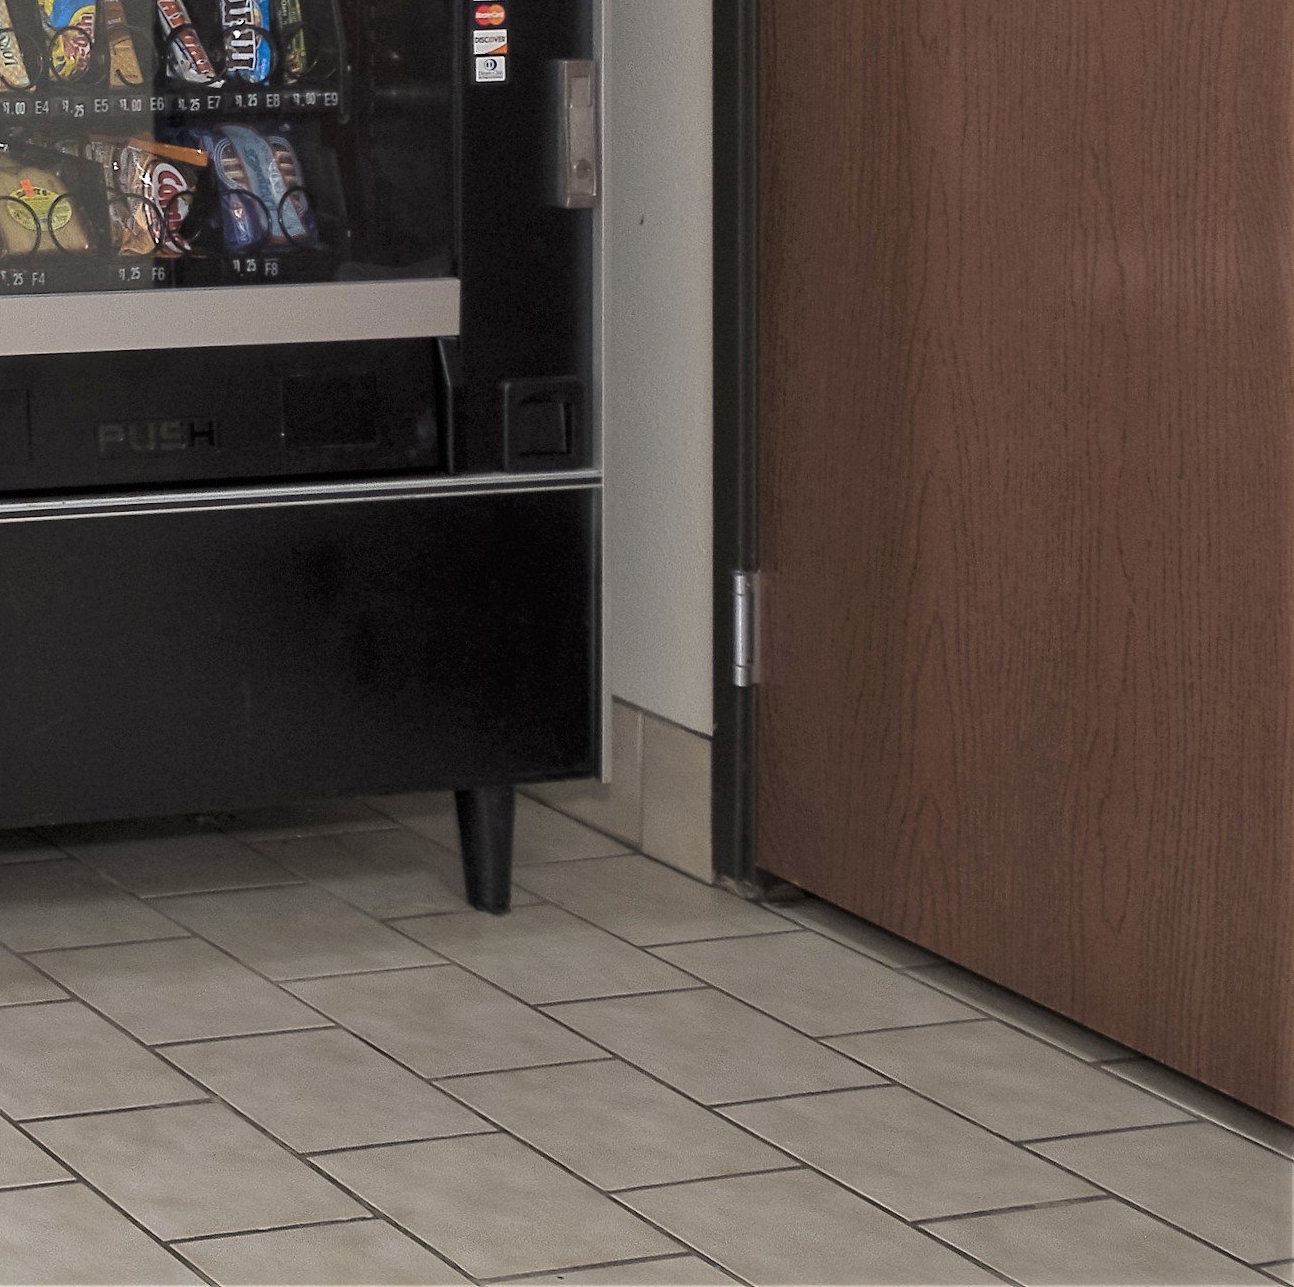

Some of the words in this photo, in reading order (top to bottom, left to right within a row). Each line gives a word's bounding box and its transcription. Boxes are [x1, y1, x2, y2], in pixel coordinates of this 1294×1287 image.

[94, 99, 109, 113] E5
[150, 98, 164, 111] E6
[208, 96, 221, 108] E7
[267, 94, 280, 107] E8
[36, 101, 49, 113] E4
[152, 268, 165, 280] F6
[265, 263, 278, 276] F8
[32, 273, 45, 285] F4
